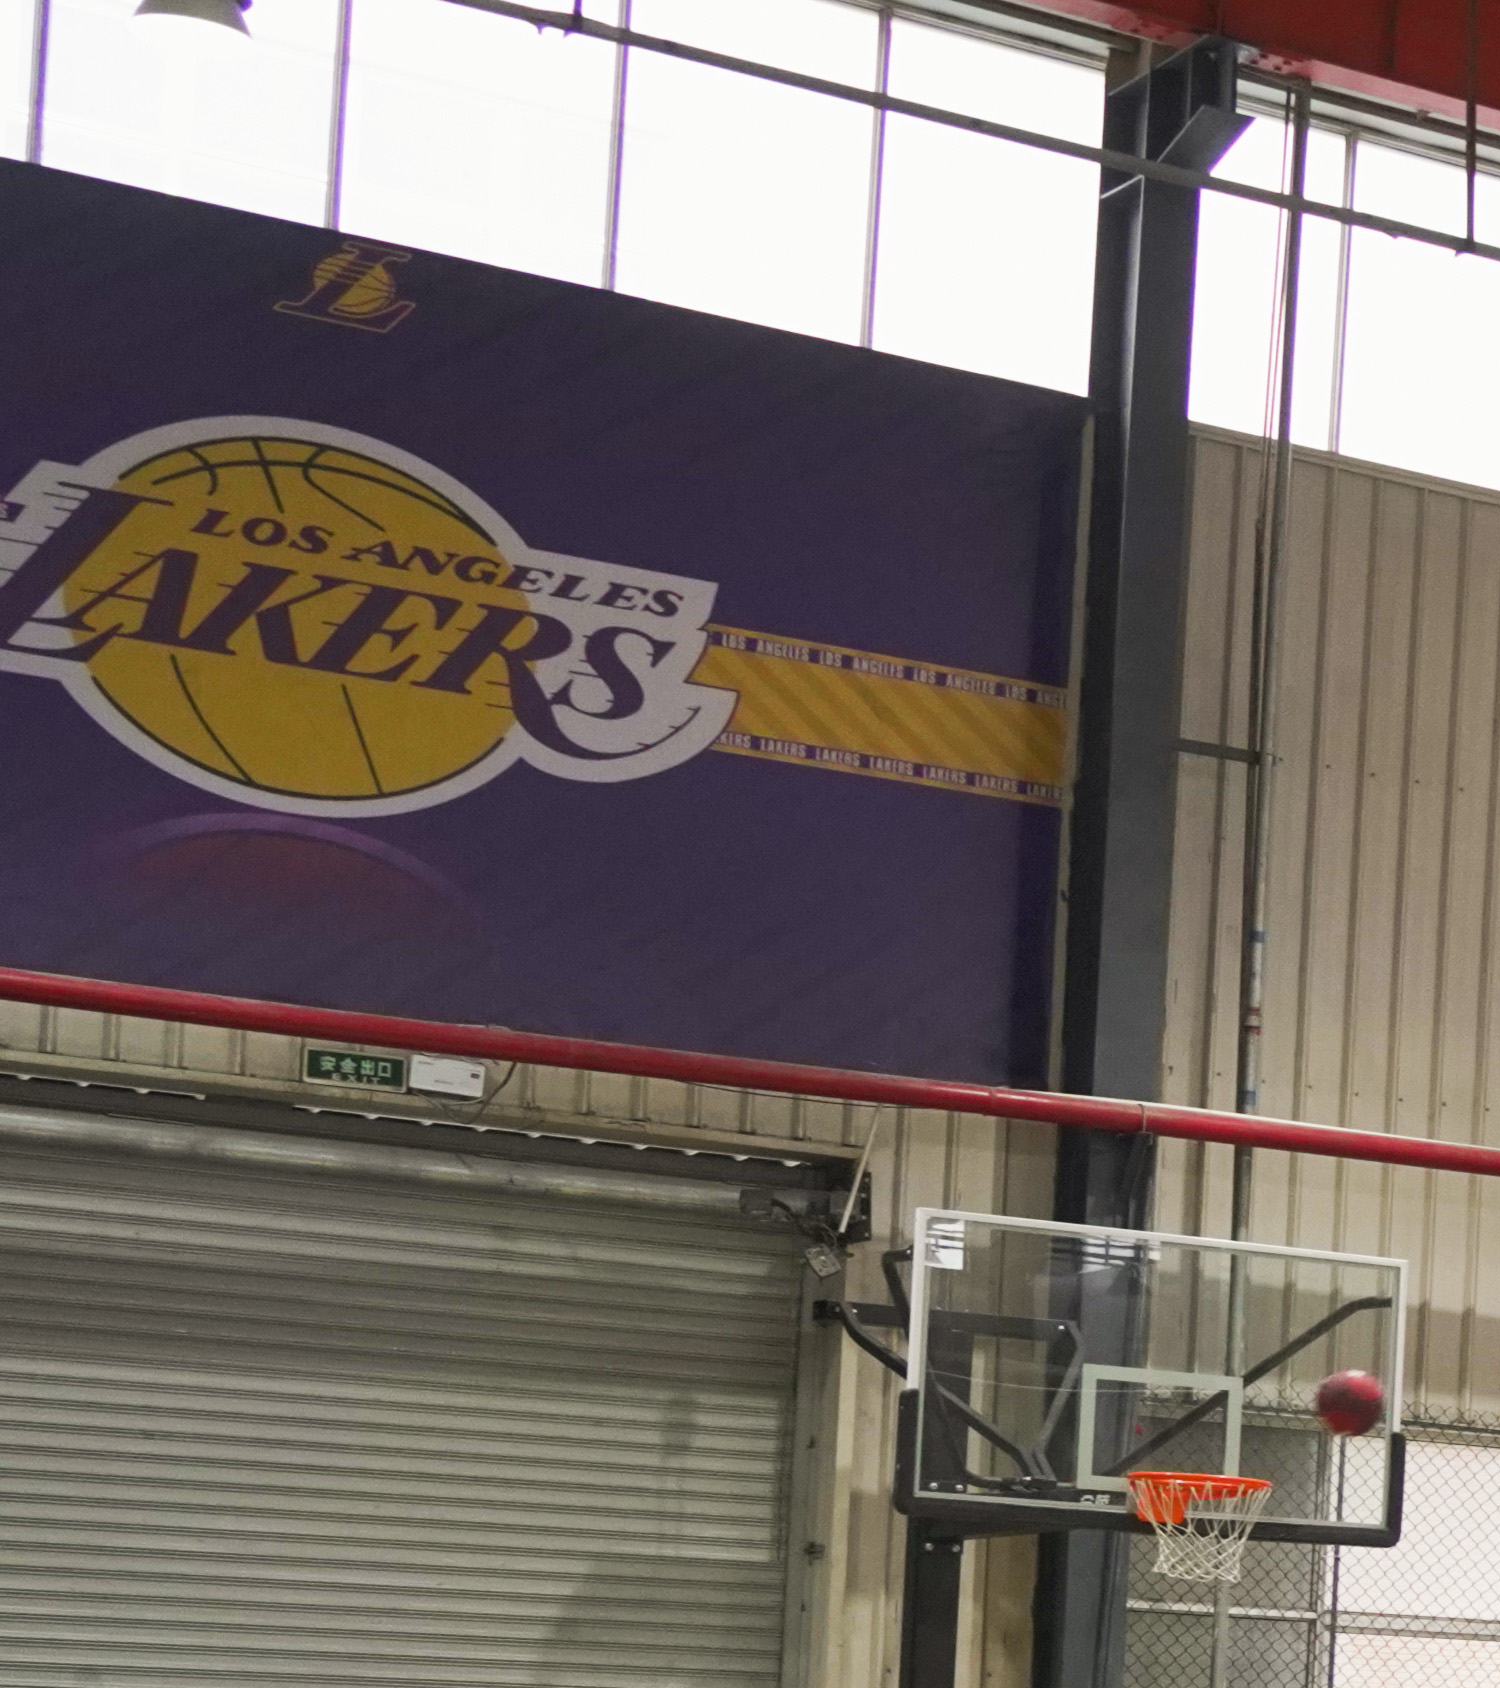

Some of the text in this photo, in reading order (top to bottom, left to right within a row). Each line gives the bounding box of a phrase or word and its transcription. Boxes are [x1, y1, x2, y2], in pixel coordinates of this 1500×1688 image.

[190, 510, 685, 617] LOS ANGELES
[0, 481, 702, 762] LAKERS
[723, 633, 746, 649] LOS
[820, 650, 842, 667] LOS
[913, 667, 936, 684] LOS
[320, 1056, 392, 1077] 安全出口
[331, 1072, 381, 1085] EXIT
